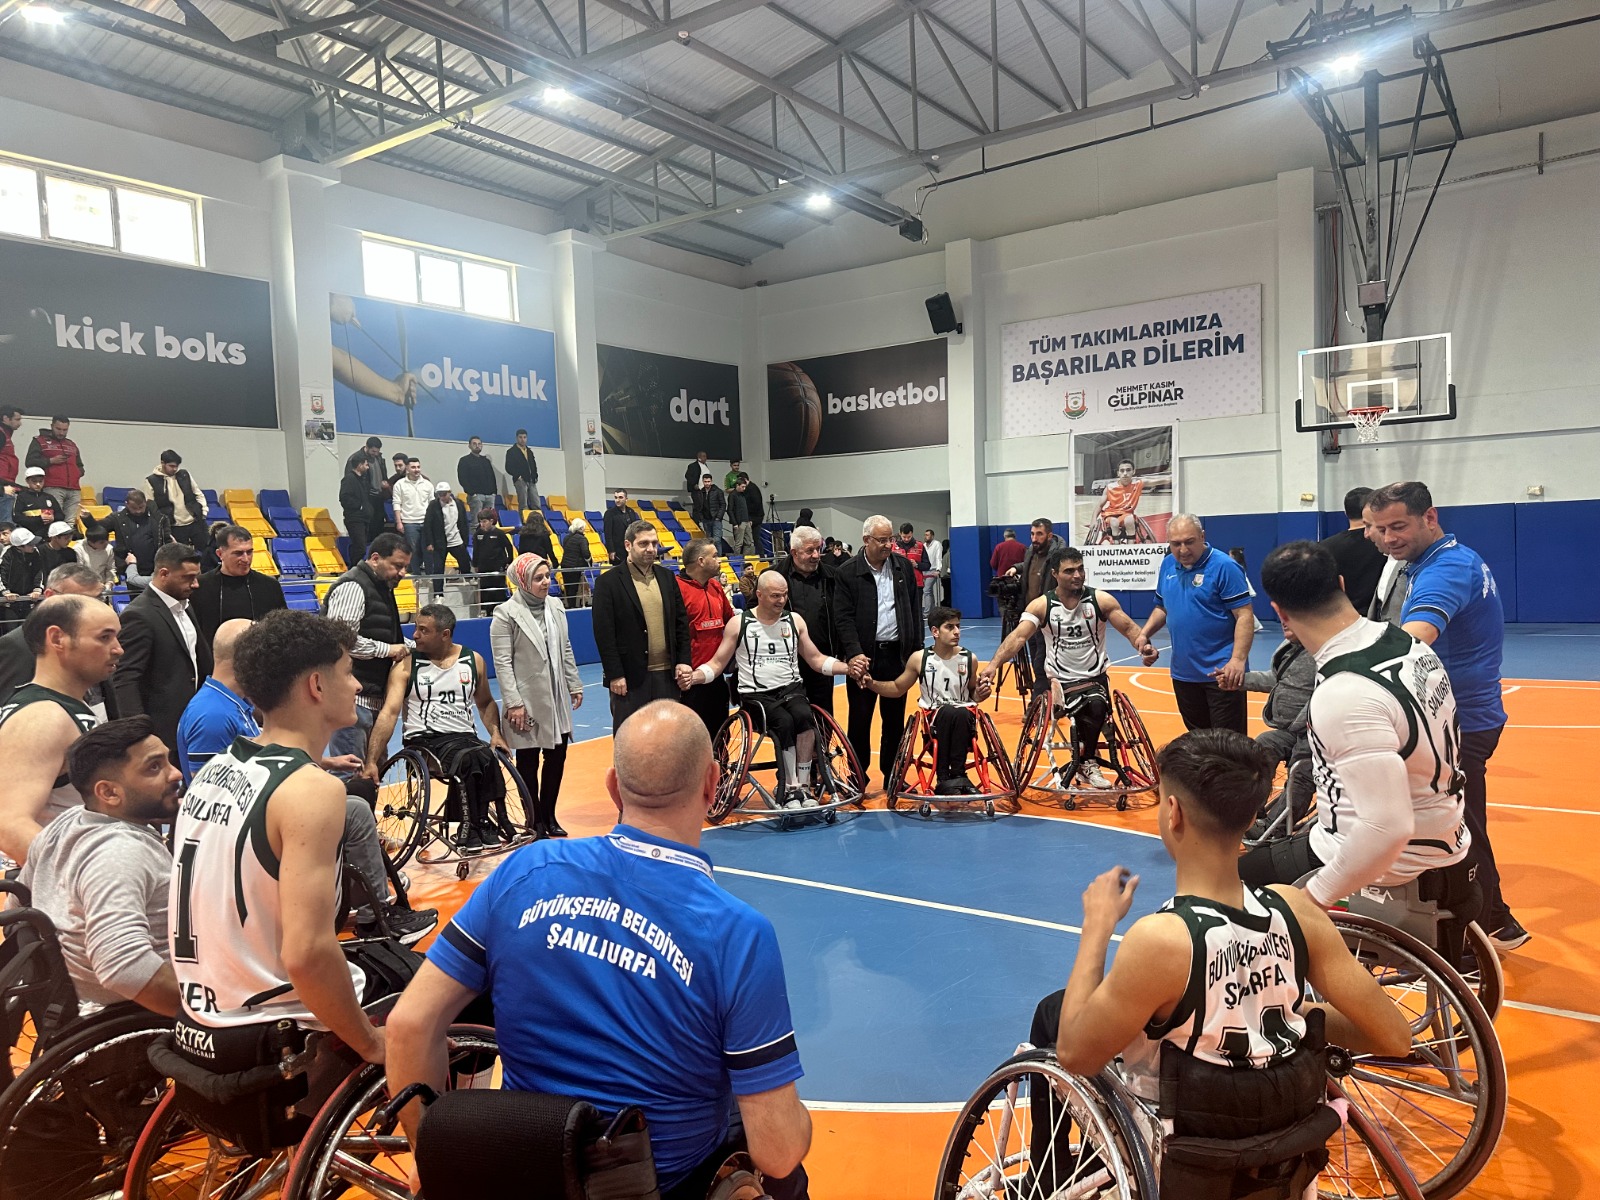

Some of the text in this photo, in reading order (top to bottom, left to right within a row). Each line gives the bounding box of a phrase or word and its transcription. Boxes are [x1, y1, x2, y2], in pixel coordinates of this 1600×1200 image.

[55, 314, 247, 365] kick boks
[1029, 312, 1223, 355] TÜM TAKIMLARIMIZA
[1012, 331, 1245, 386] BAŞARILAR DİLERİM
[421, 356, 548, 402] okçuluk
[827, 376, 946, 415] basketbol
[1116, 380, 1175, 394] MEHMET KASIM
[669, 388, 730, 426] dart
[1107, 387, 1184, 408] GÜLPINAR
[1097, 545, 1166, 557] UNUTMAYACAĞI
[1098, 558, 1151, 567] MUHAMMED
[768, 642, 776, 655] 9
[1066, 625, 1082, 637] 23
[438, 690, 456, 704] 20
[943, 677, 950, 692] 7
[173, 838, 201, 964] 1
[517, 893, 694, 987] BÜYÜKŞEHİR BELEDİYESİ
[546, 922, 657, 980] ŞANLIURFA
[175, 1020, 215, 1052] EXTRA
